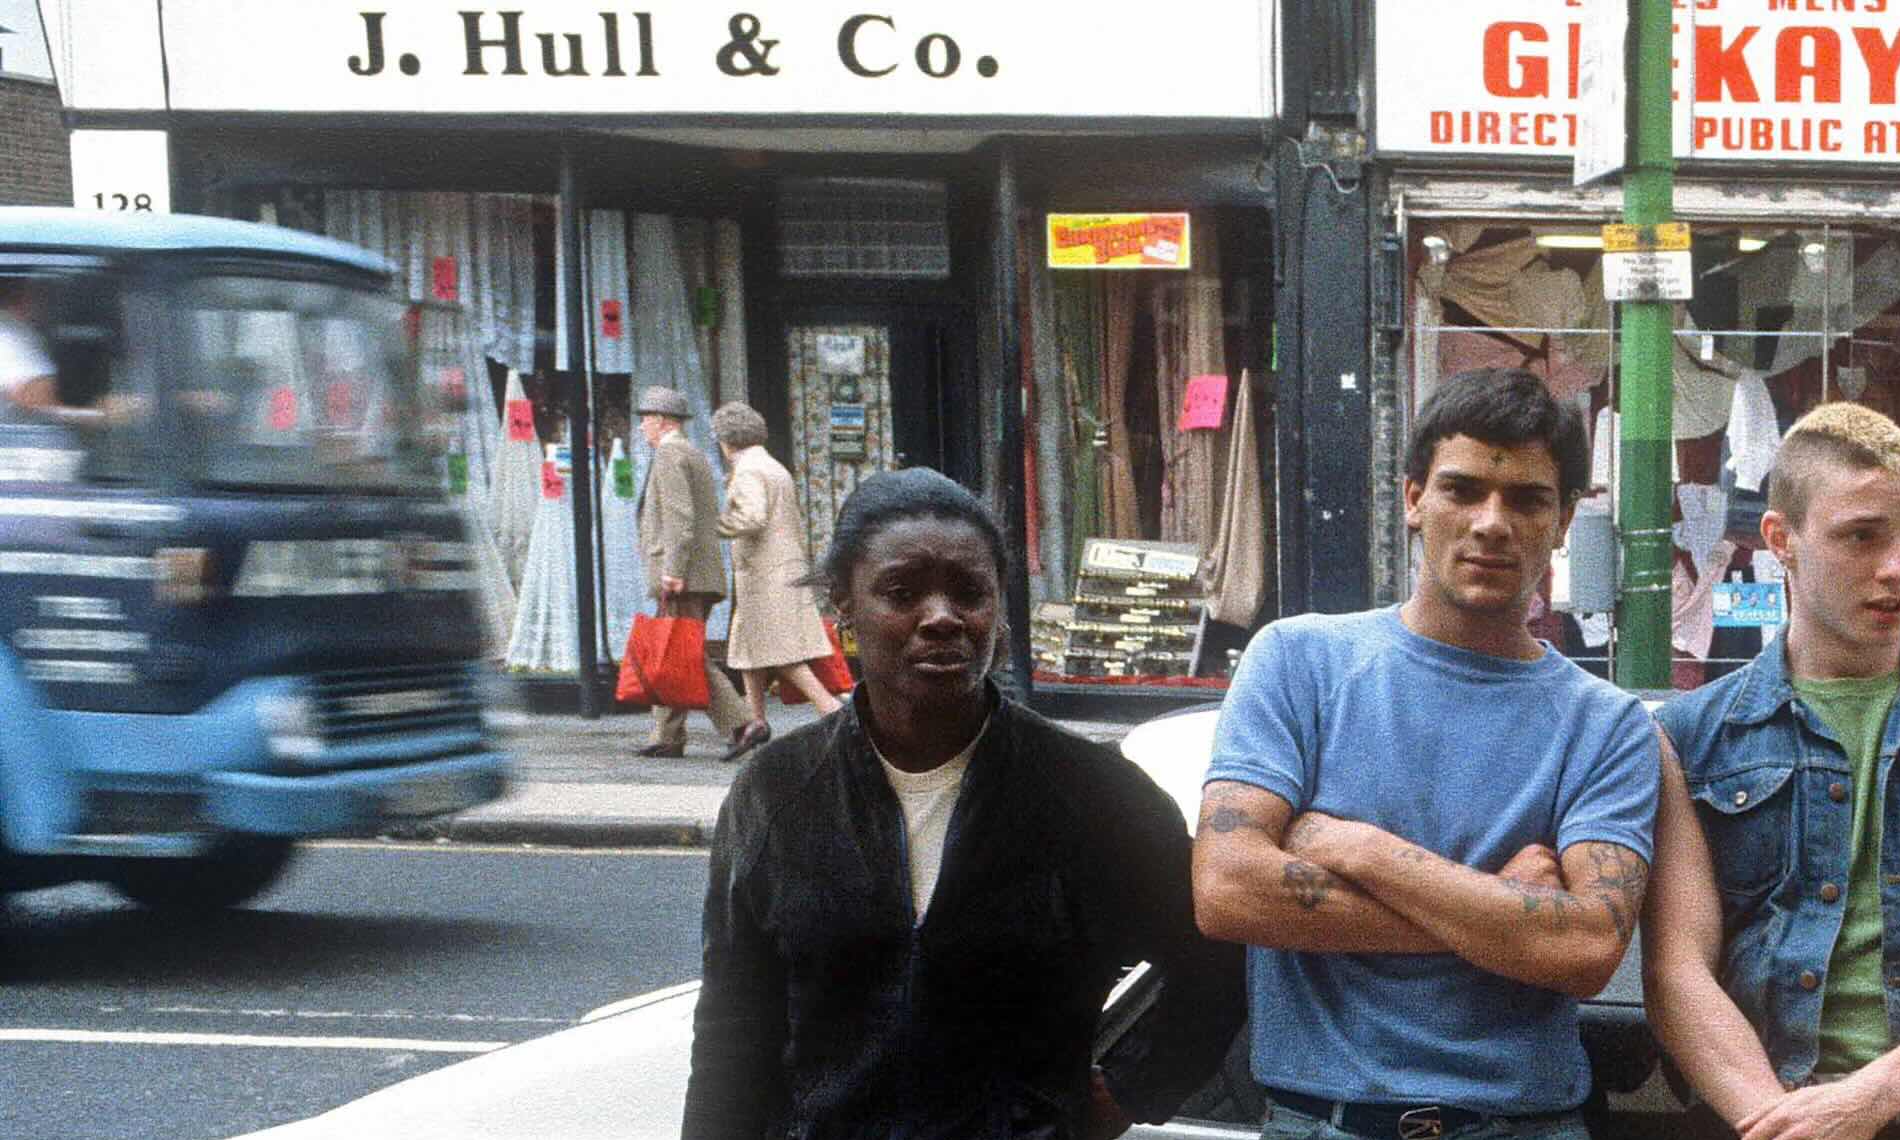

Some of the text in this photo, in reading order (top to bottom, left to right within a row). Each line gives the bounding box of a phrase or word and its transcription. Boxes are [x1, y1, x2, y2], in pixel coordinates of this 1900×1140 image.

[347, 11, 999, 78] J. Hull & Co.
[1693, 115, 1843, 153] PUBLIC
